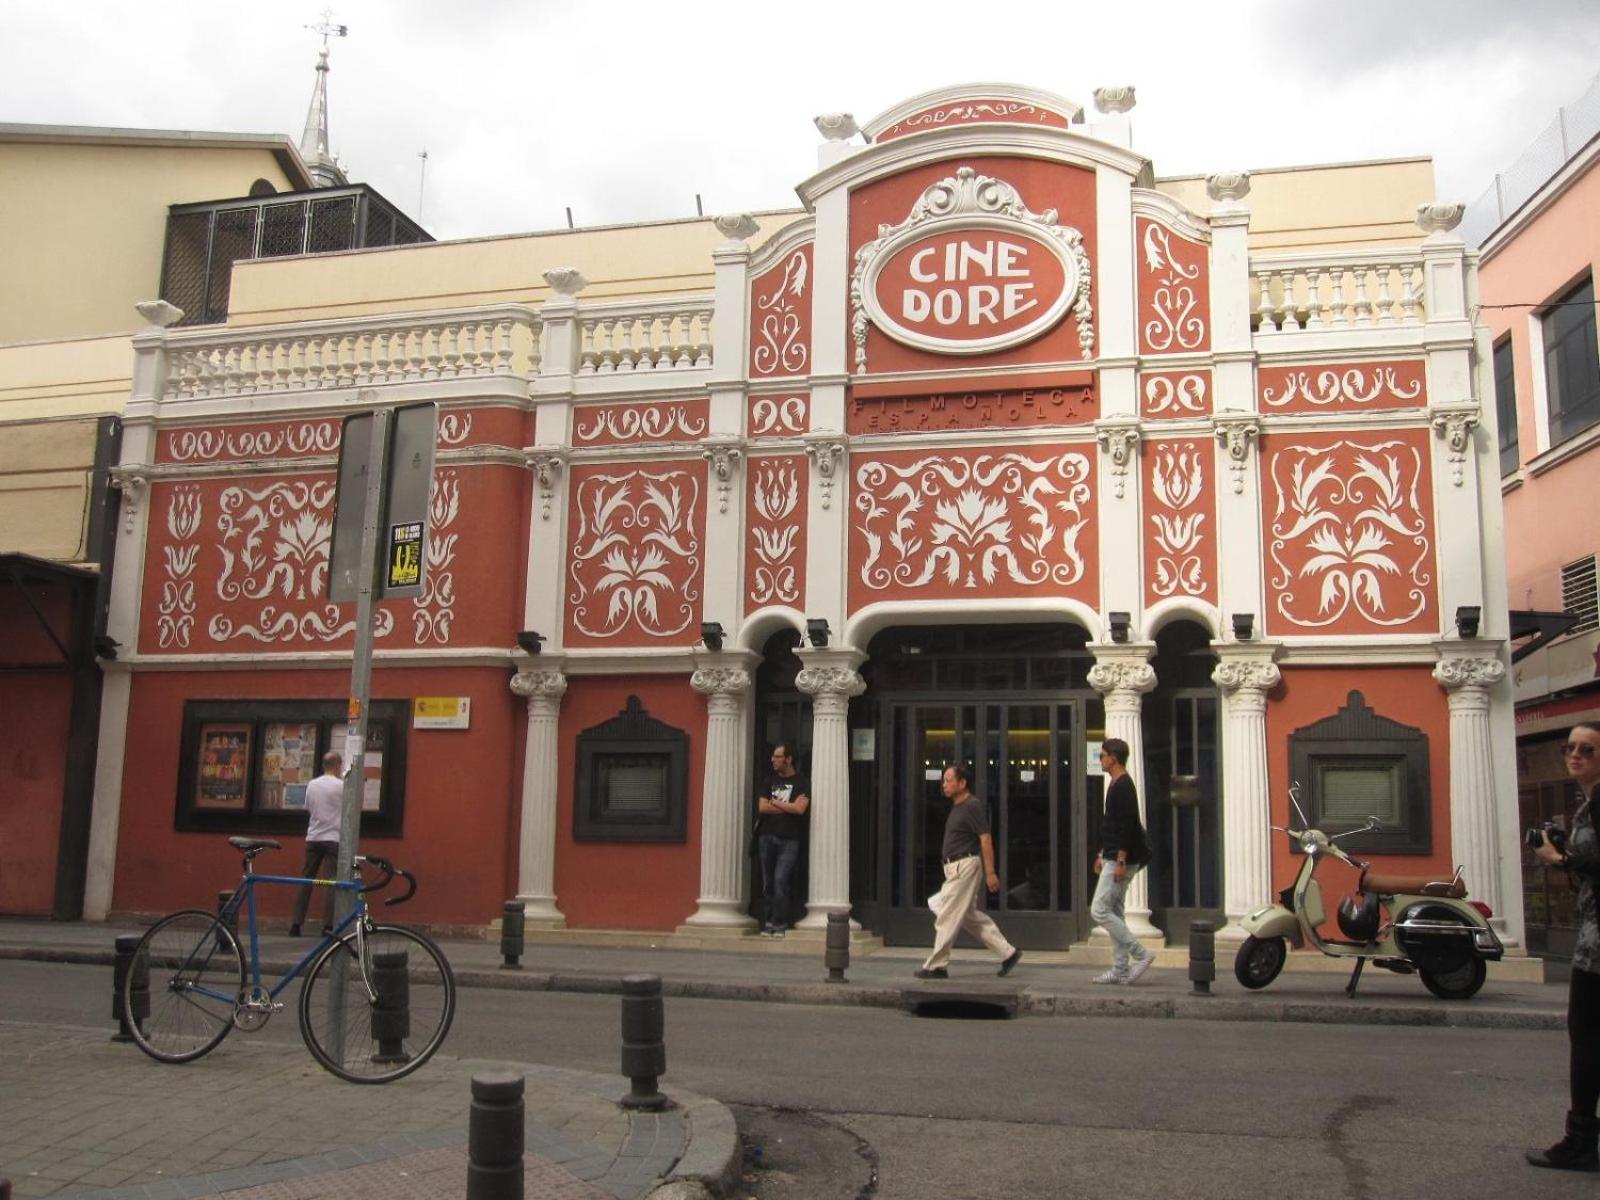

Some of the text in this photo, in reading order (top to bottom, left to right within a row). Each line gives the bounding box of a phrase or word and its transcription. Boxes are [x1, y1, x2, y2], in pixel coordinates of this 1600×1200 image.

[909, 240, 1031, 283] CINE
[902, 282, 1038, 325] DORE
[853, 387, 1094, 416] FILMOTECA
[869, 405, 1078, 428] ESPAÑOLA
